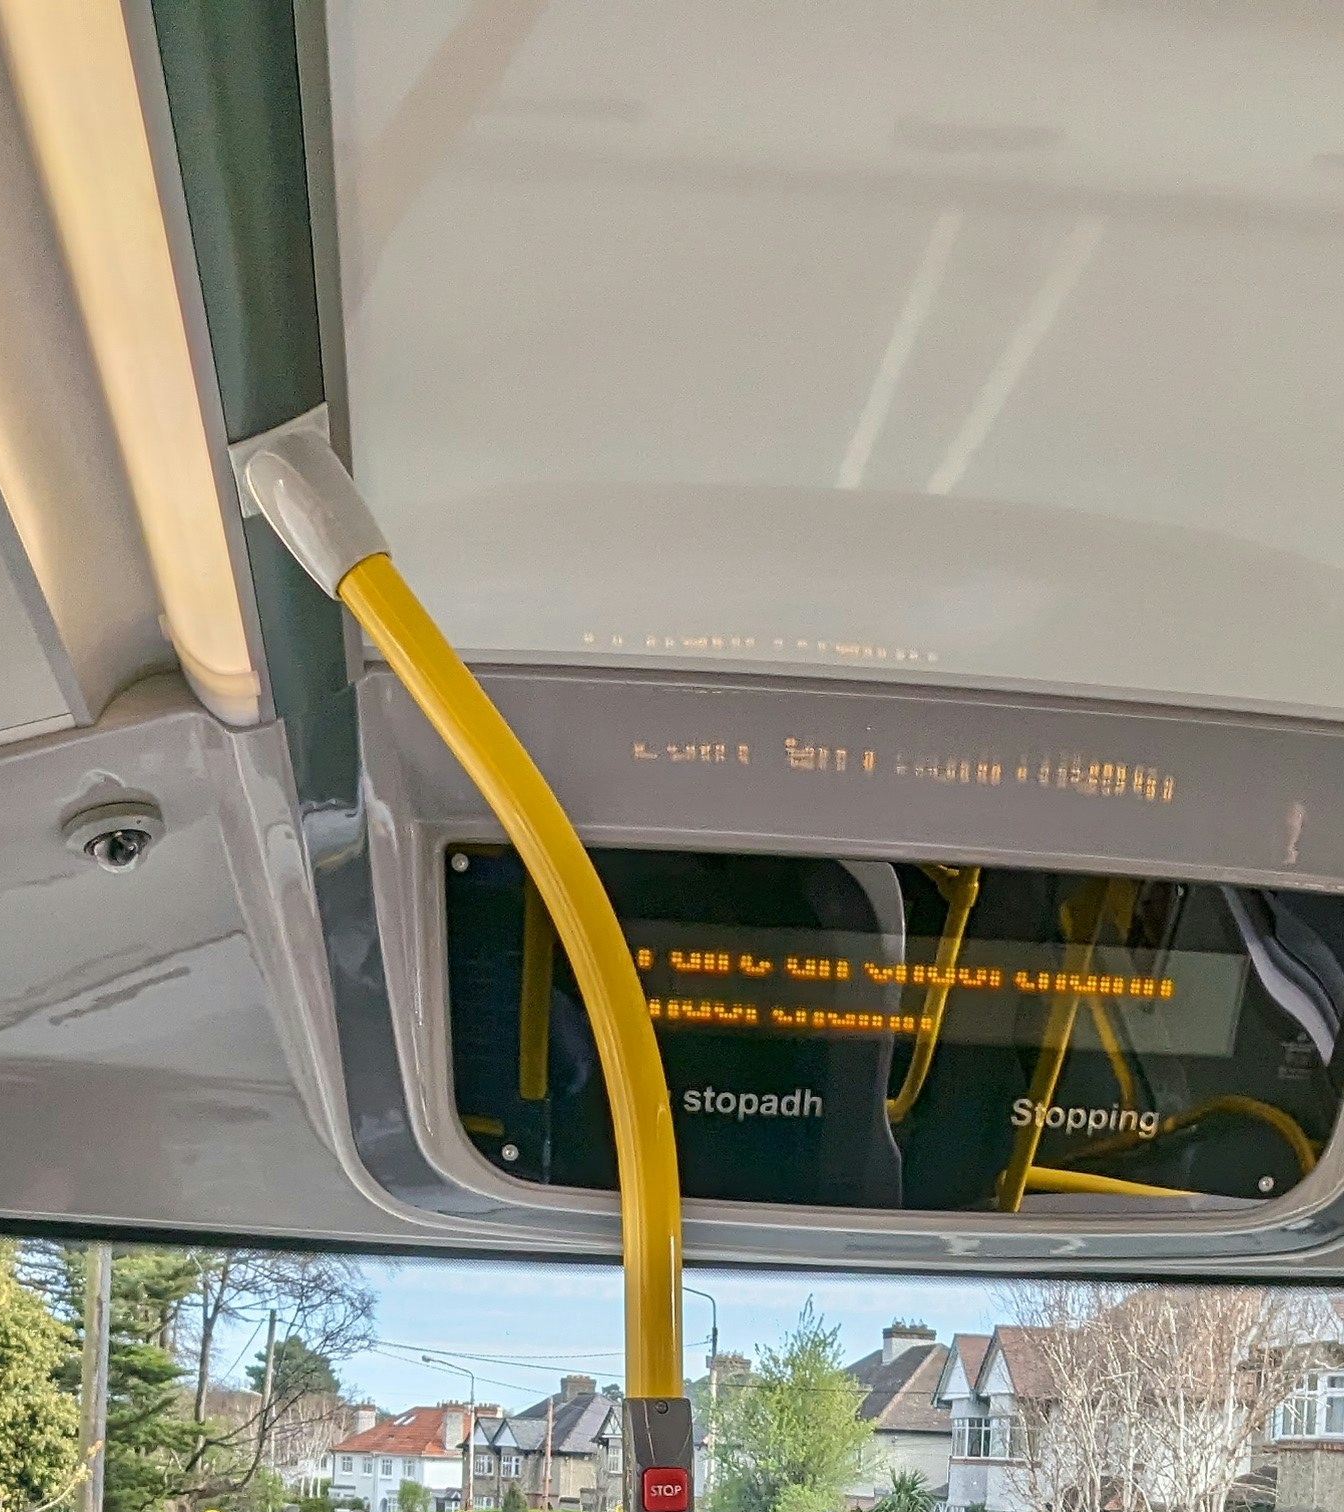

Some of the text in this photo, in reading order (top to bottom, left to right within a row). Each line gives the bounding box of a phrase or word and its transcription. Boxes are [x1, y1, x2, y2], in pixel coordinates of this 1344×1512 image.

[682, 1086, 824, 1122] stopadh
[1010, 1098, 1160, 1139] Stopping
[650, 1484, 682, 1497] STOP
